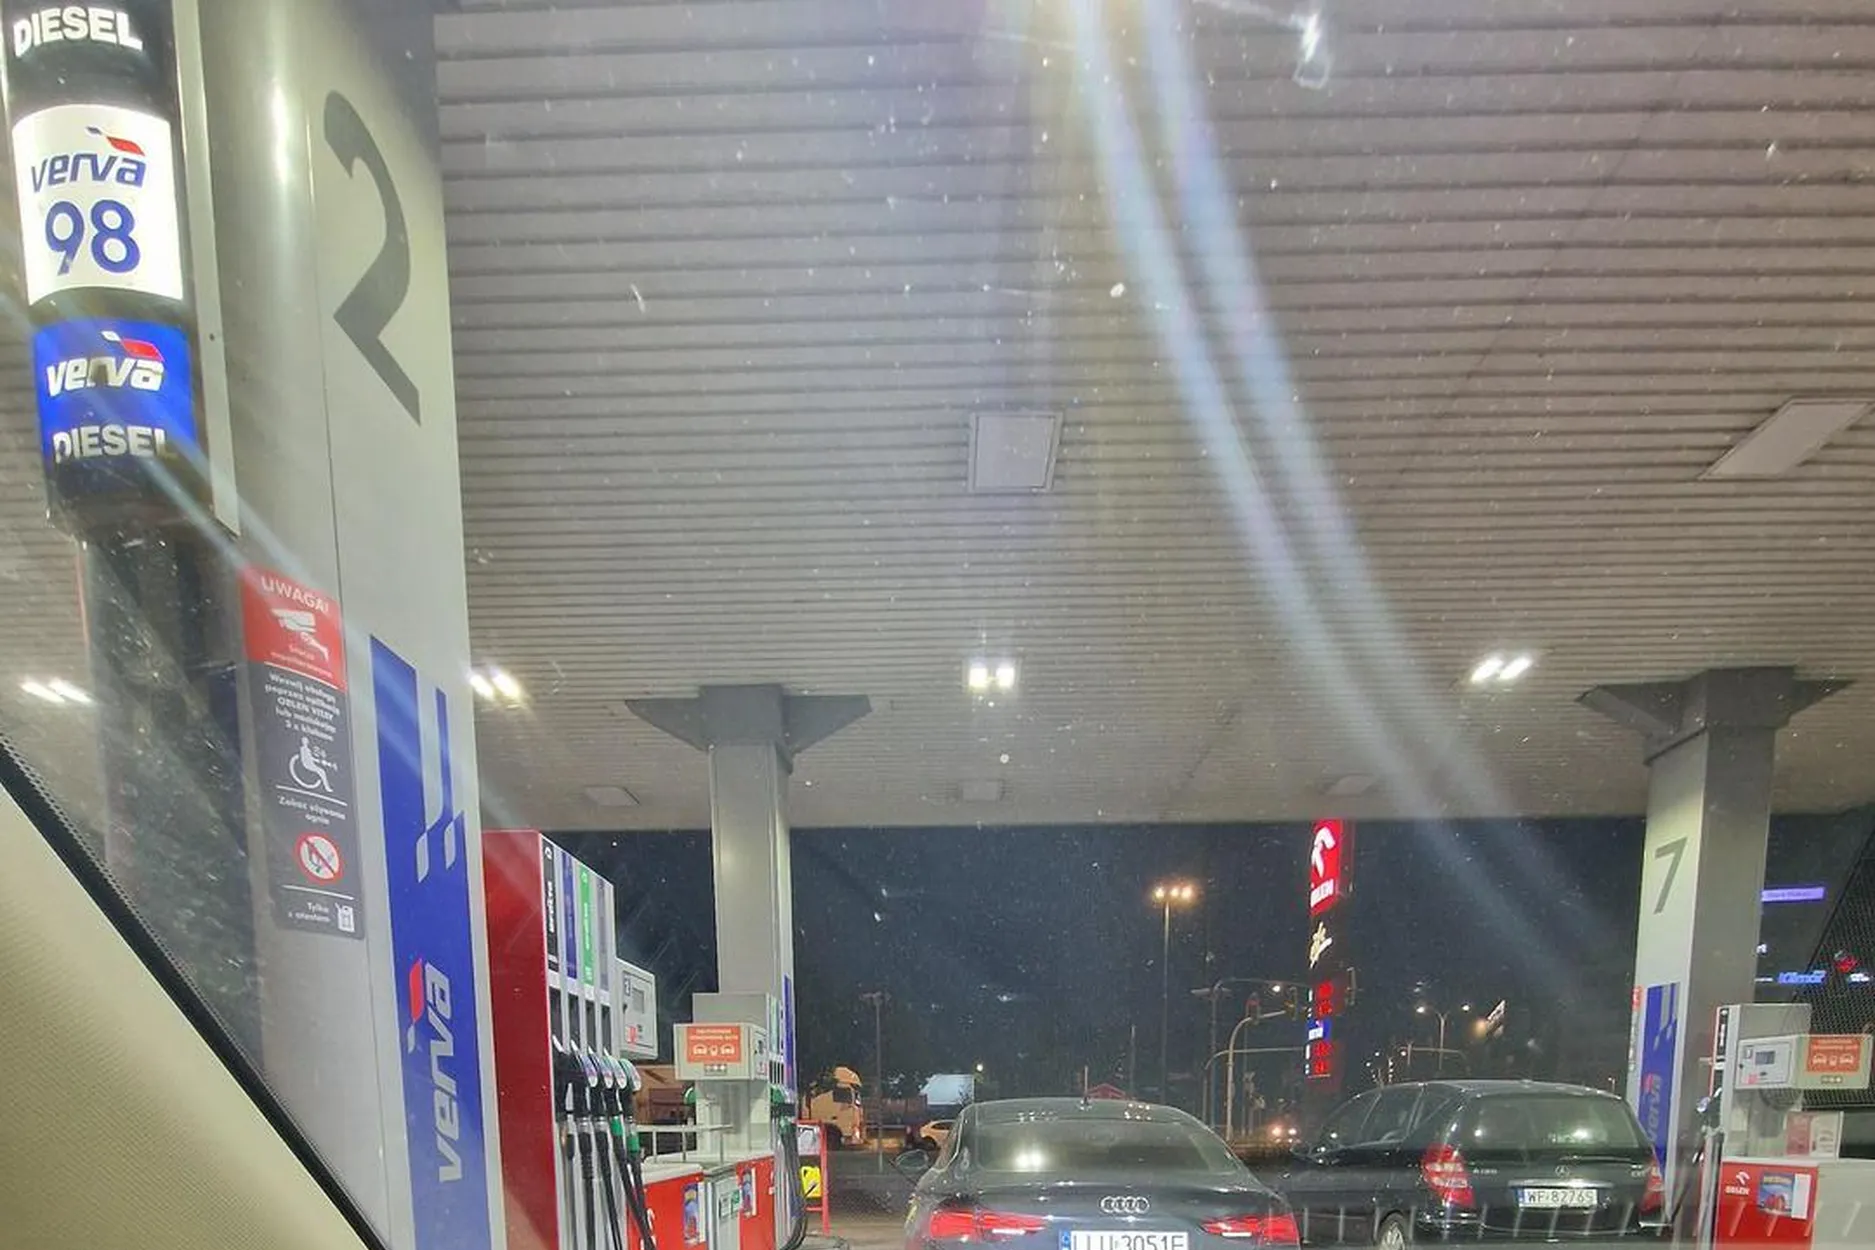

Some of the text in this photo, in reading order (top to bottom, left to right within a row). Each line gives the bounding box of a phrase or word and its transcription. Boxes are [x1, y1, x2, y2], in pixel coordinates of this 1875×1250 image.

[13, 6, 143, 57] DIESEL
[31, 153, 147, 193] verva
[45, 200, 141, 276] 98
[323, 90, 421, 426] 2
[46, 356, 165, 397] verva
[53, 424, 178, 465] DIESEL
[260, 576, 330, 612] UWAGA!
[1654, 836, 1688, 914] 7
[425, 962, 463, 1183] verva
